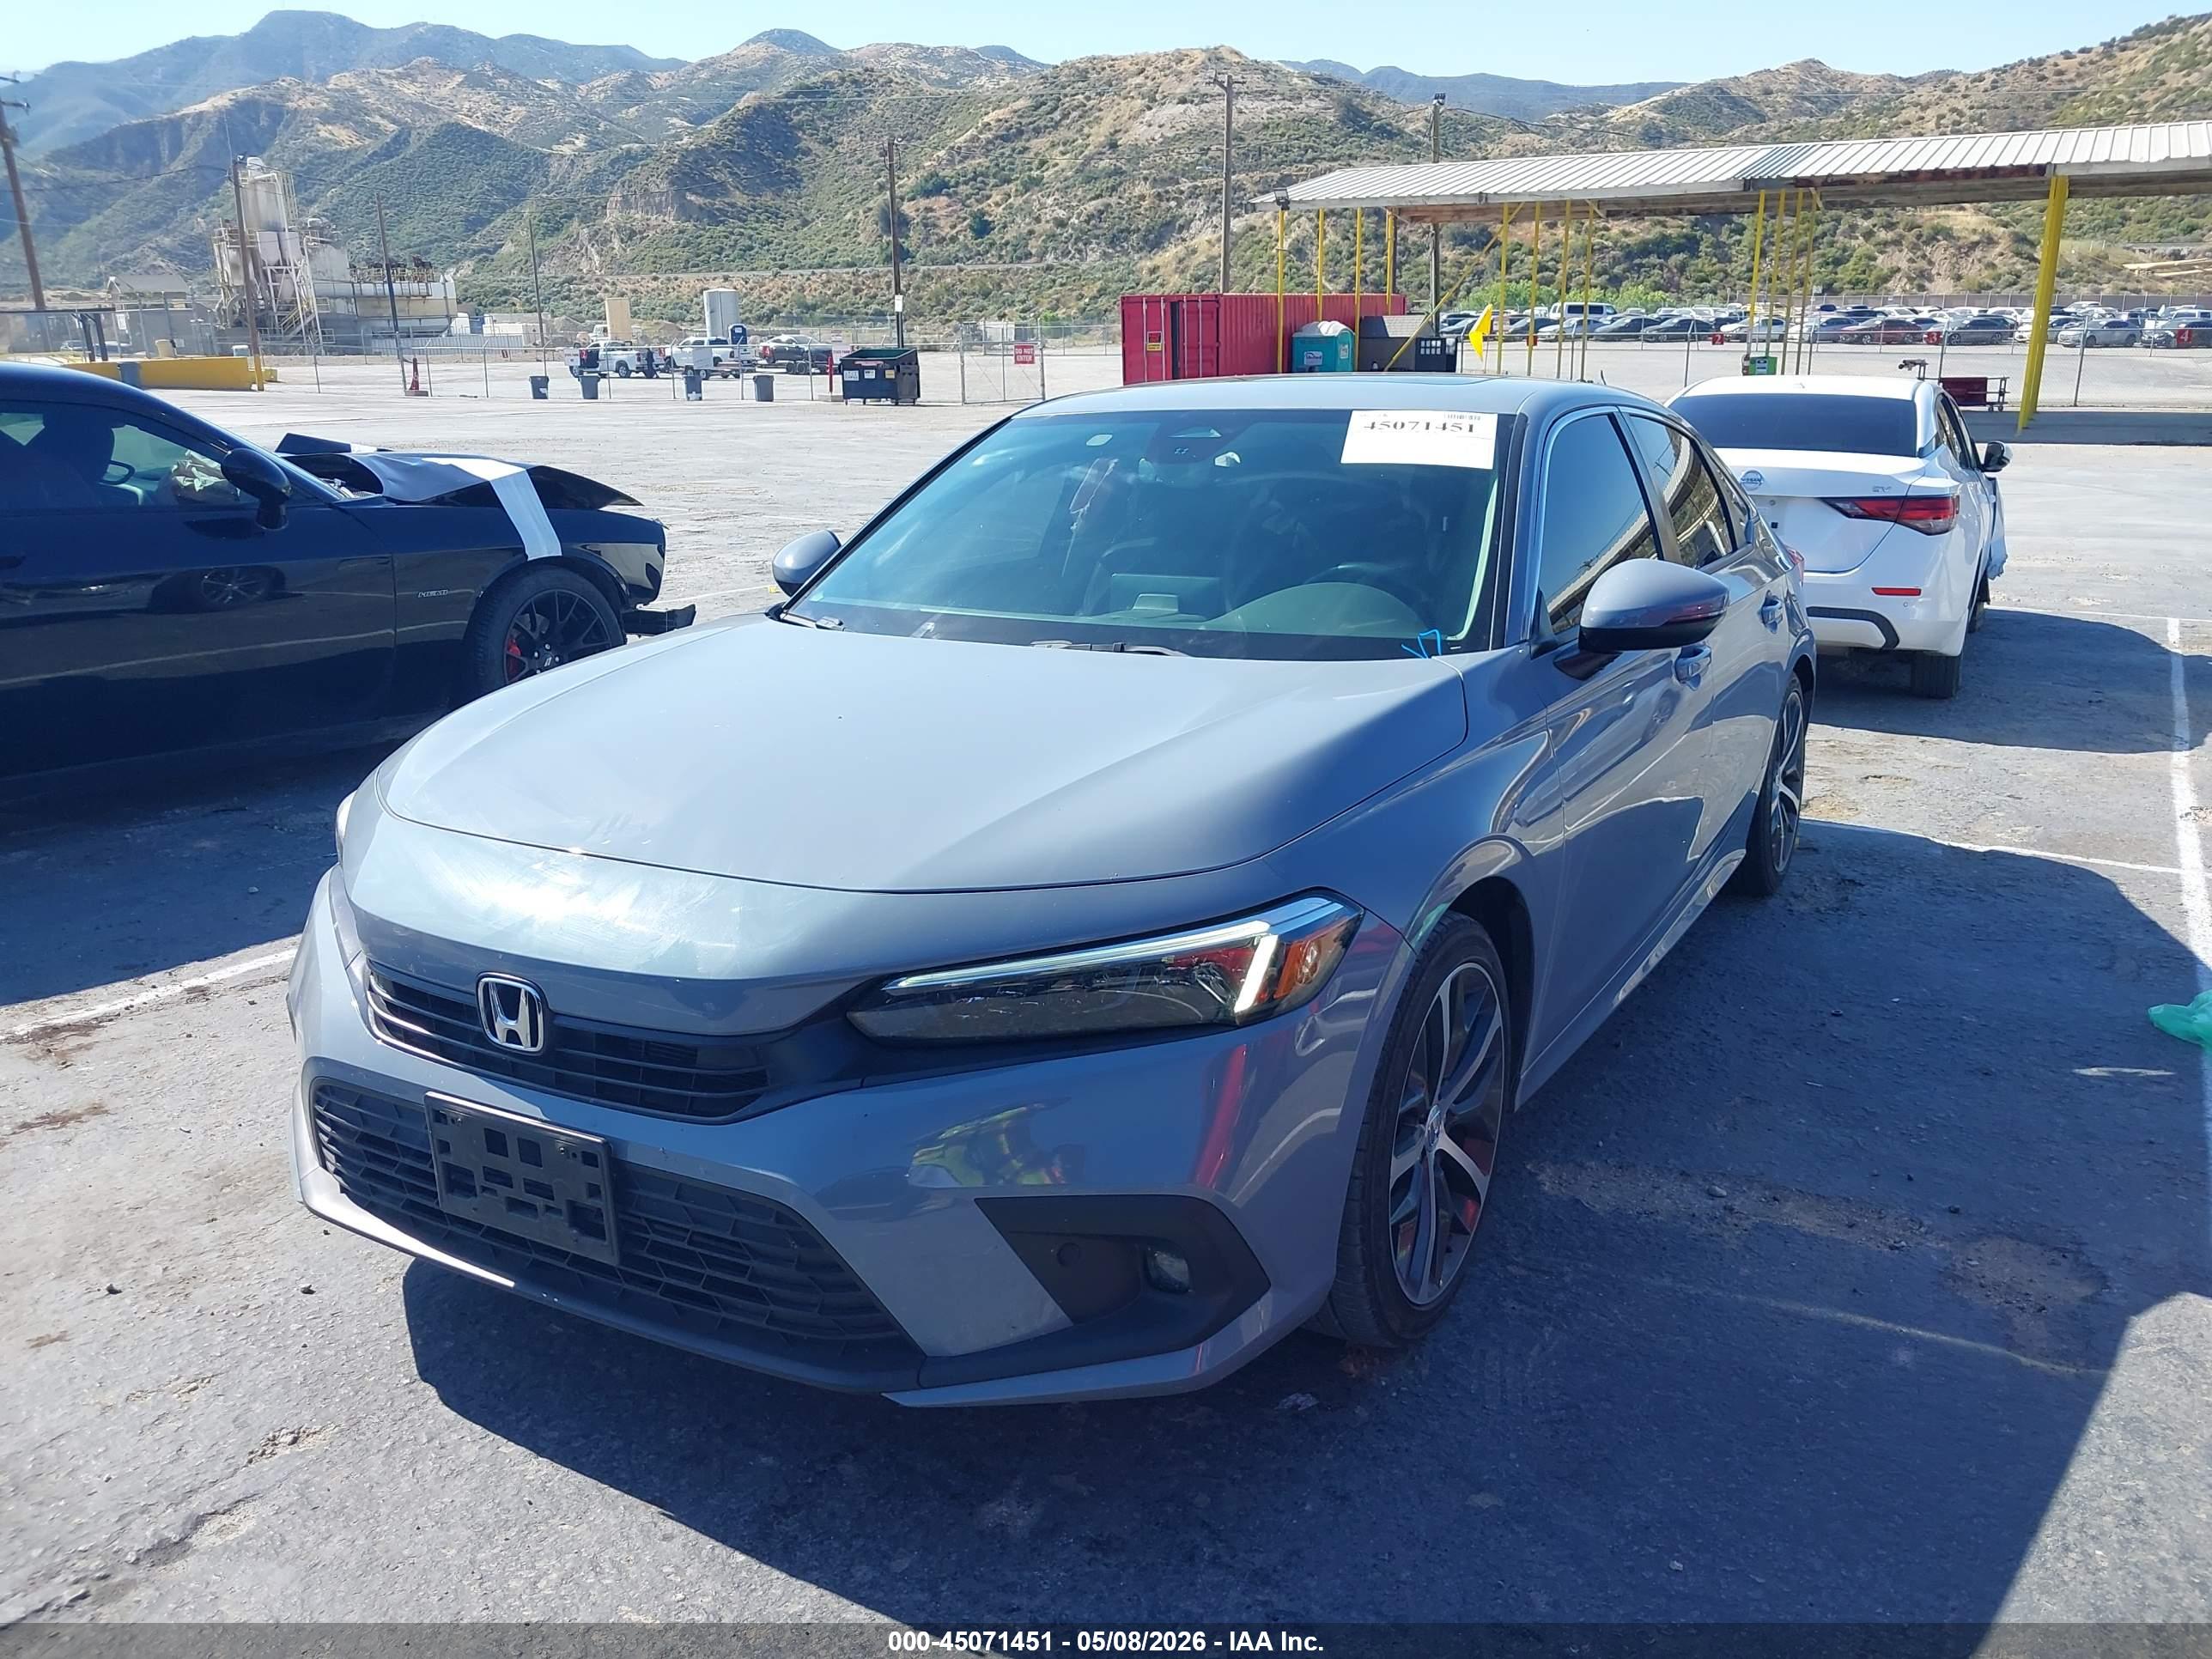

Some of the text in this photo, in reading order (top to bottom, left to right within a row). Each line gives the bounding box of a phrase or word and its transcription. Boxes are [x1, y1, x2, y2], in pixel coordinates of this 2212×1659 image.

[1716, 334, 1722, 343] 2
[1931, 332, 1937, 343] 3
[2180, 330, 2189, 342] 4
[1364, 420, 1474, 434] 45071451
